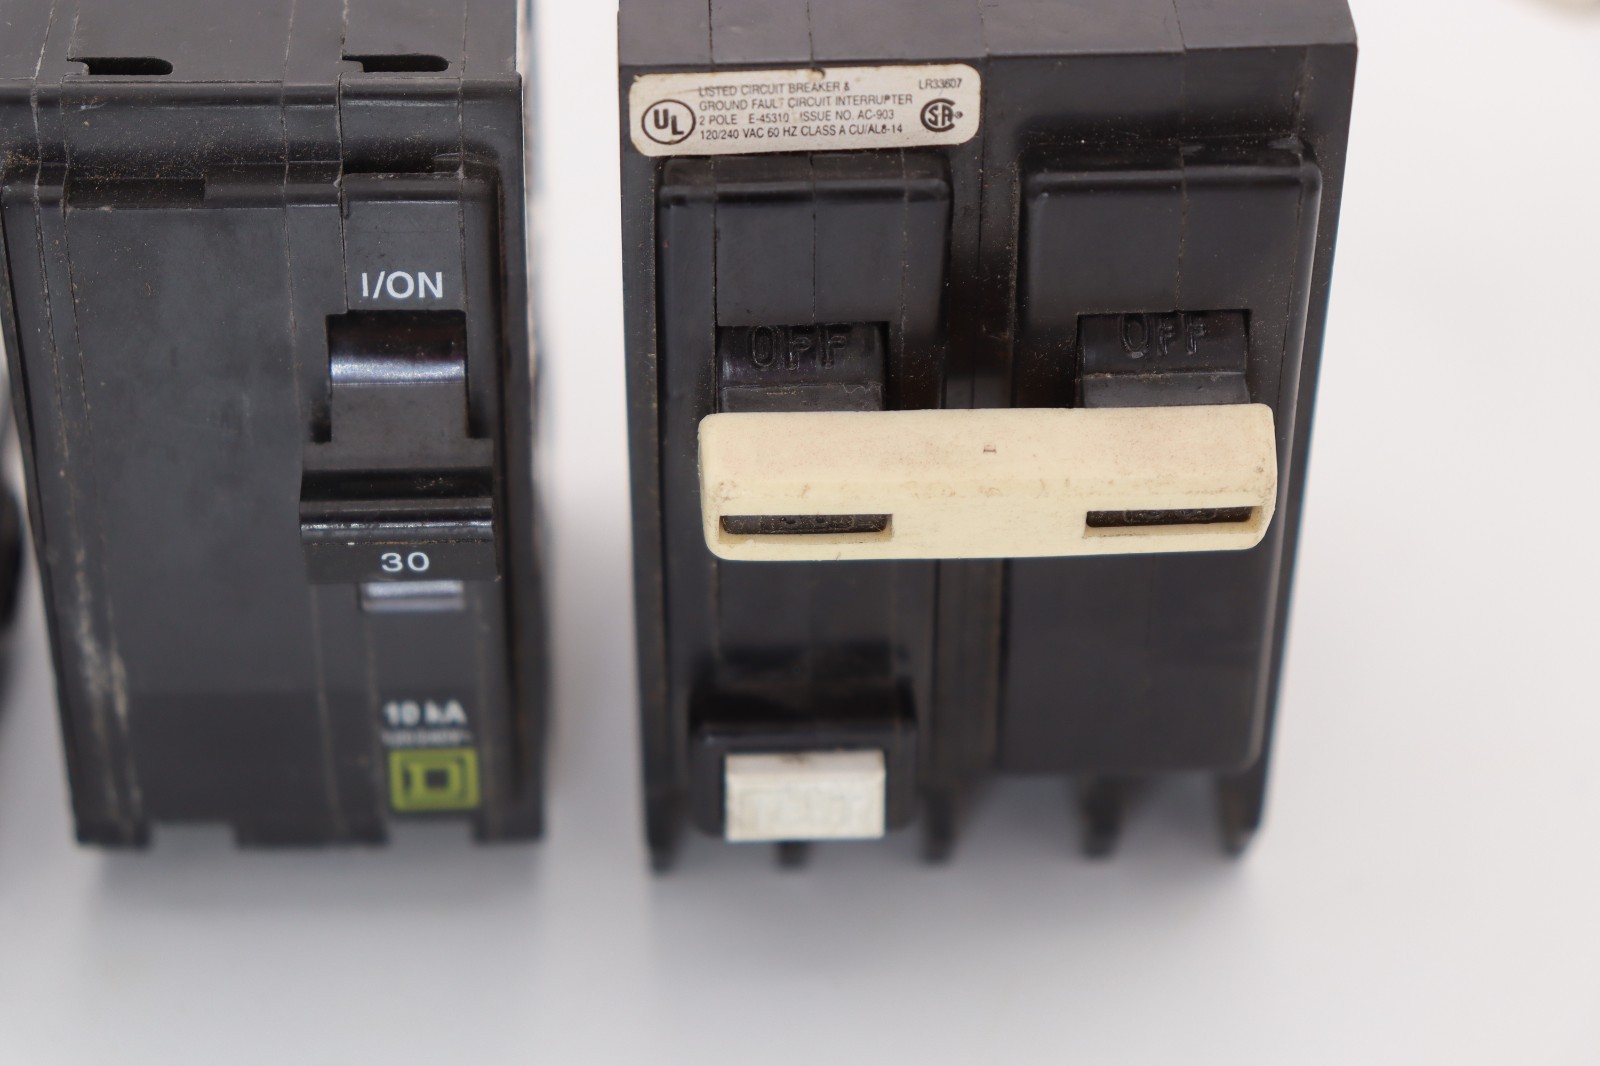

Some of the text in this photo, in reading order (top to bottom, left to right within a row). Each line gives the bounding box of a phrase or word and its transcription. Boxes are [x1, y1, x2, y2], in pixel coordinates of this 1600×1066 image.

[699, 81, 850, 97] LISTED CIRCUIT BREAKER &
[699, 99, 748, 111] GROUND
[787, 95, 831, 108] CIRCUIT
[835, 94, 913, 106] INTERRUPTER
[653, 108, 685, 136] UL
[699, 108, 895, 126] 2 POLE E-45310 ISSUE NO. AC-903
[700, 129, 739, 141] 120/240
[742, 127, 764, 139] VAC
[767, 127, 779, 138] 60
[783, 125, 798, 137] HZ
[800, 124, 836, 136] CLASS
[838, 124, 846, 135] A
[361, 270, 443, 299] I/ON
[380, 551, 430, 572] 30
